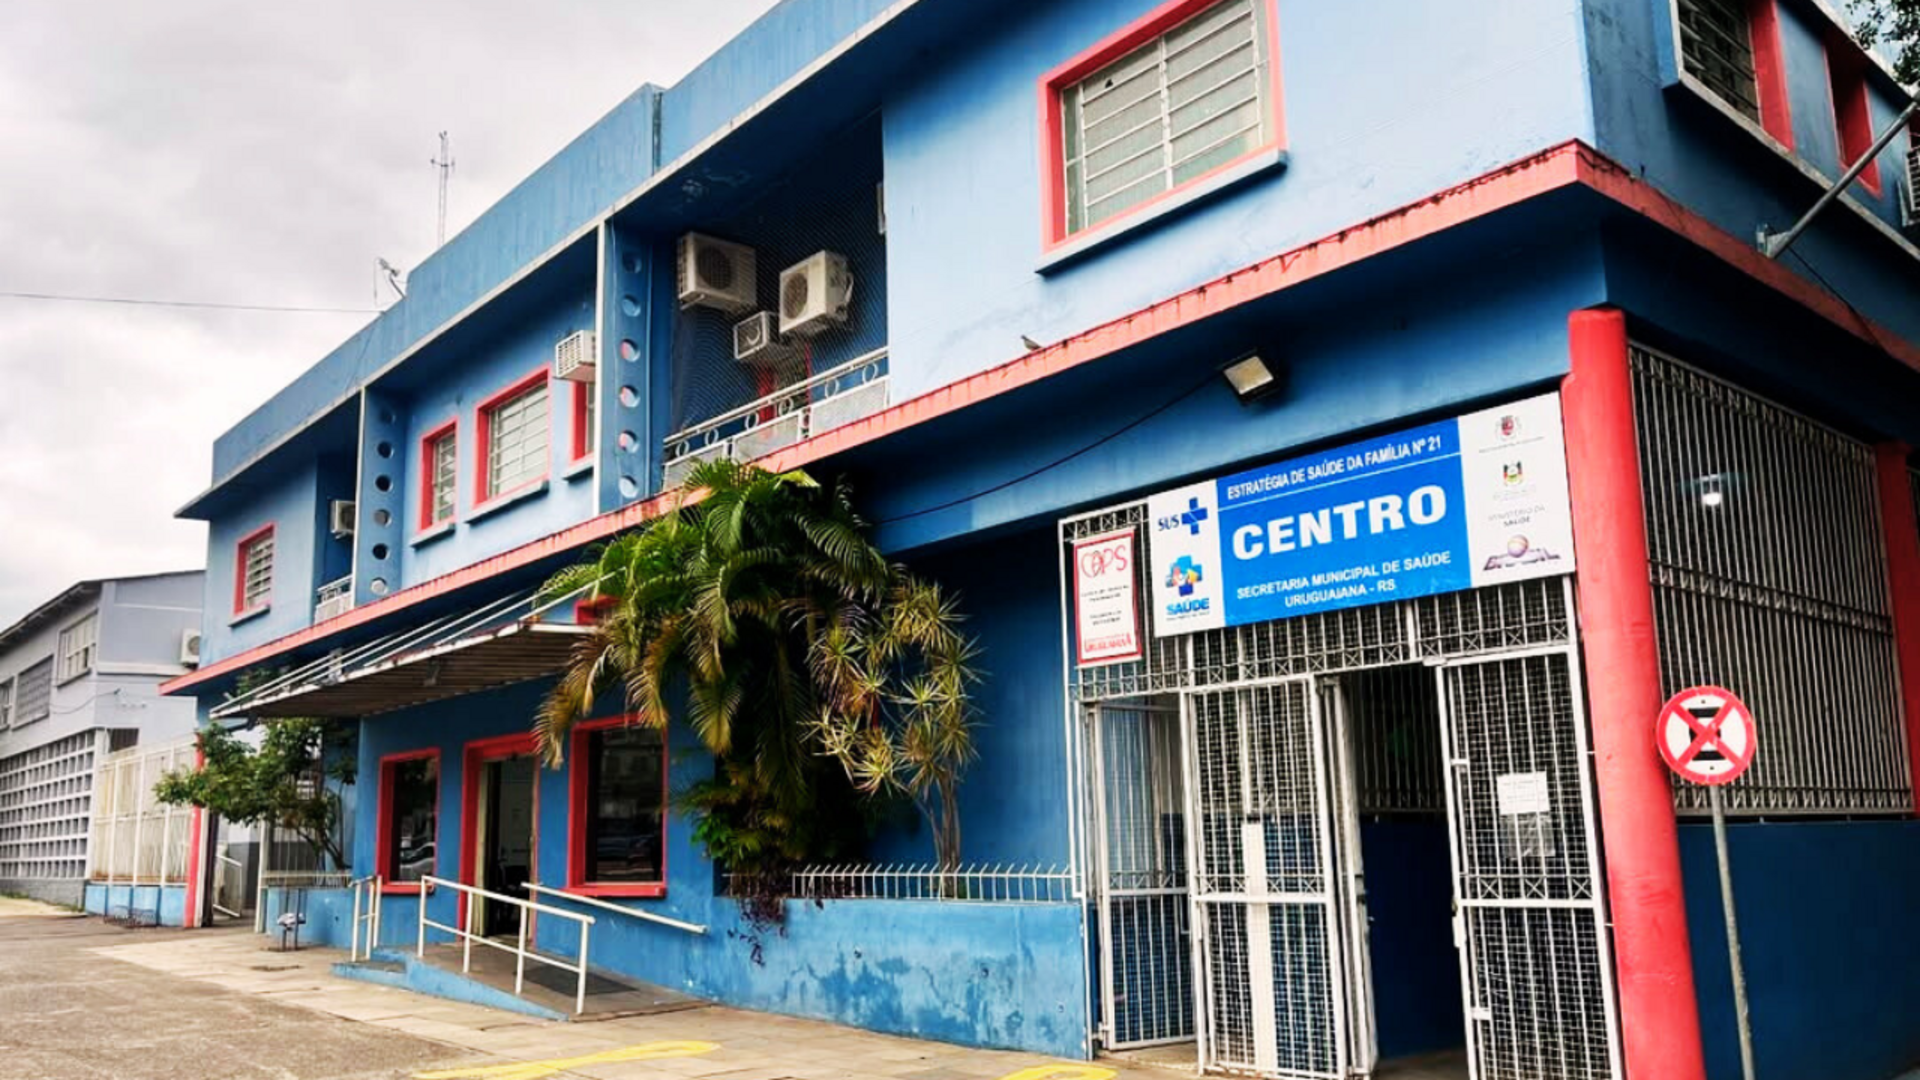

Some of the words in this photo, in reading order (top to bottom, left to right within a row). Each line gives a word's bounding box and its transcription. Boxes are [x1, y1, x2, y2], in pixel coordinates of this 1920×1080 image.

[1227, 473, 1290, 500] ESTRATÉGIA
[1290, 467, 1306, 485] DE
[1307, 459, 1345, 481] SAÚDE
[1347, 453, 1364, 471] DA
[1364, 443, 1411, 467] FAMÍLIA
[1428, 434, 1442, 452] 21
[1157, 514, 1180, 532] SUS
[1232, 484, 1447, 561] CENTRO
[1080, 544, 1128, 579] CAPS
[1236, 576, 1309, 600] SECRETARIA
[1311, 566, 1380, 587] MUNICIPAL
[1382, 559, 1401, 573] DE
[1403, 550, 1452, 571] SAÚDE
[1165, 598, 1210, 616] SAÚDE
[1284, 588, 1368, 608] URUGUAIANA
[1377, 578, 1396, 592] RS
